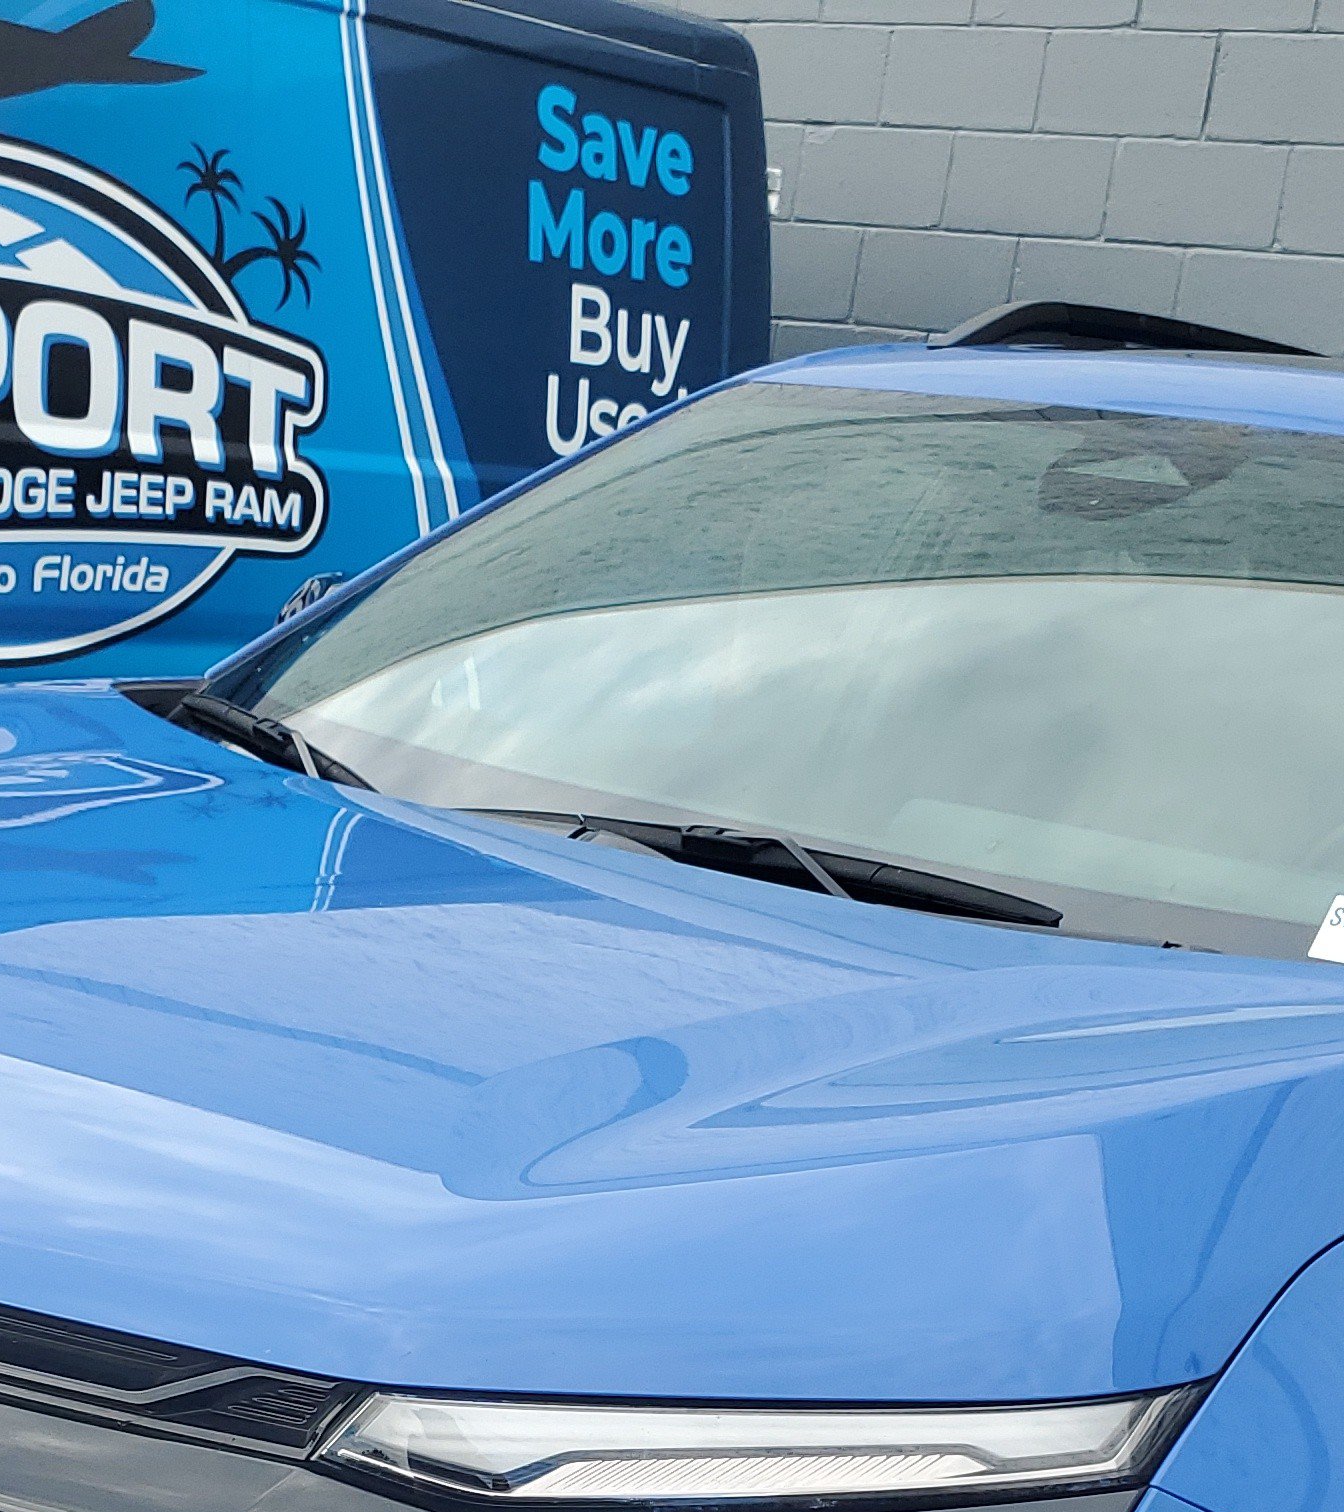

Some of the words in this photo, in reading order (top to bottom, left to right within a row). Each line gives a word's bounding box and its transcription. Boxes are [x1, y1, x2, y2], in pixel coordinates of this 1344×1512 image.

[536, 83, 694, 197] Save
[528, 179, 694, 288] More
[569, 283, 690, 397] Buy
[546, 373, 688, 457] Us
[86, 470, 196, 521] JEEP
[205, 479, 303, 532] RAM
[32, 554, 171, 594] Florida
